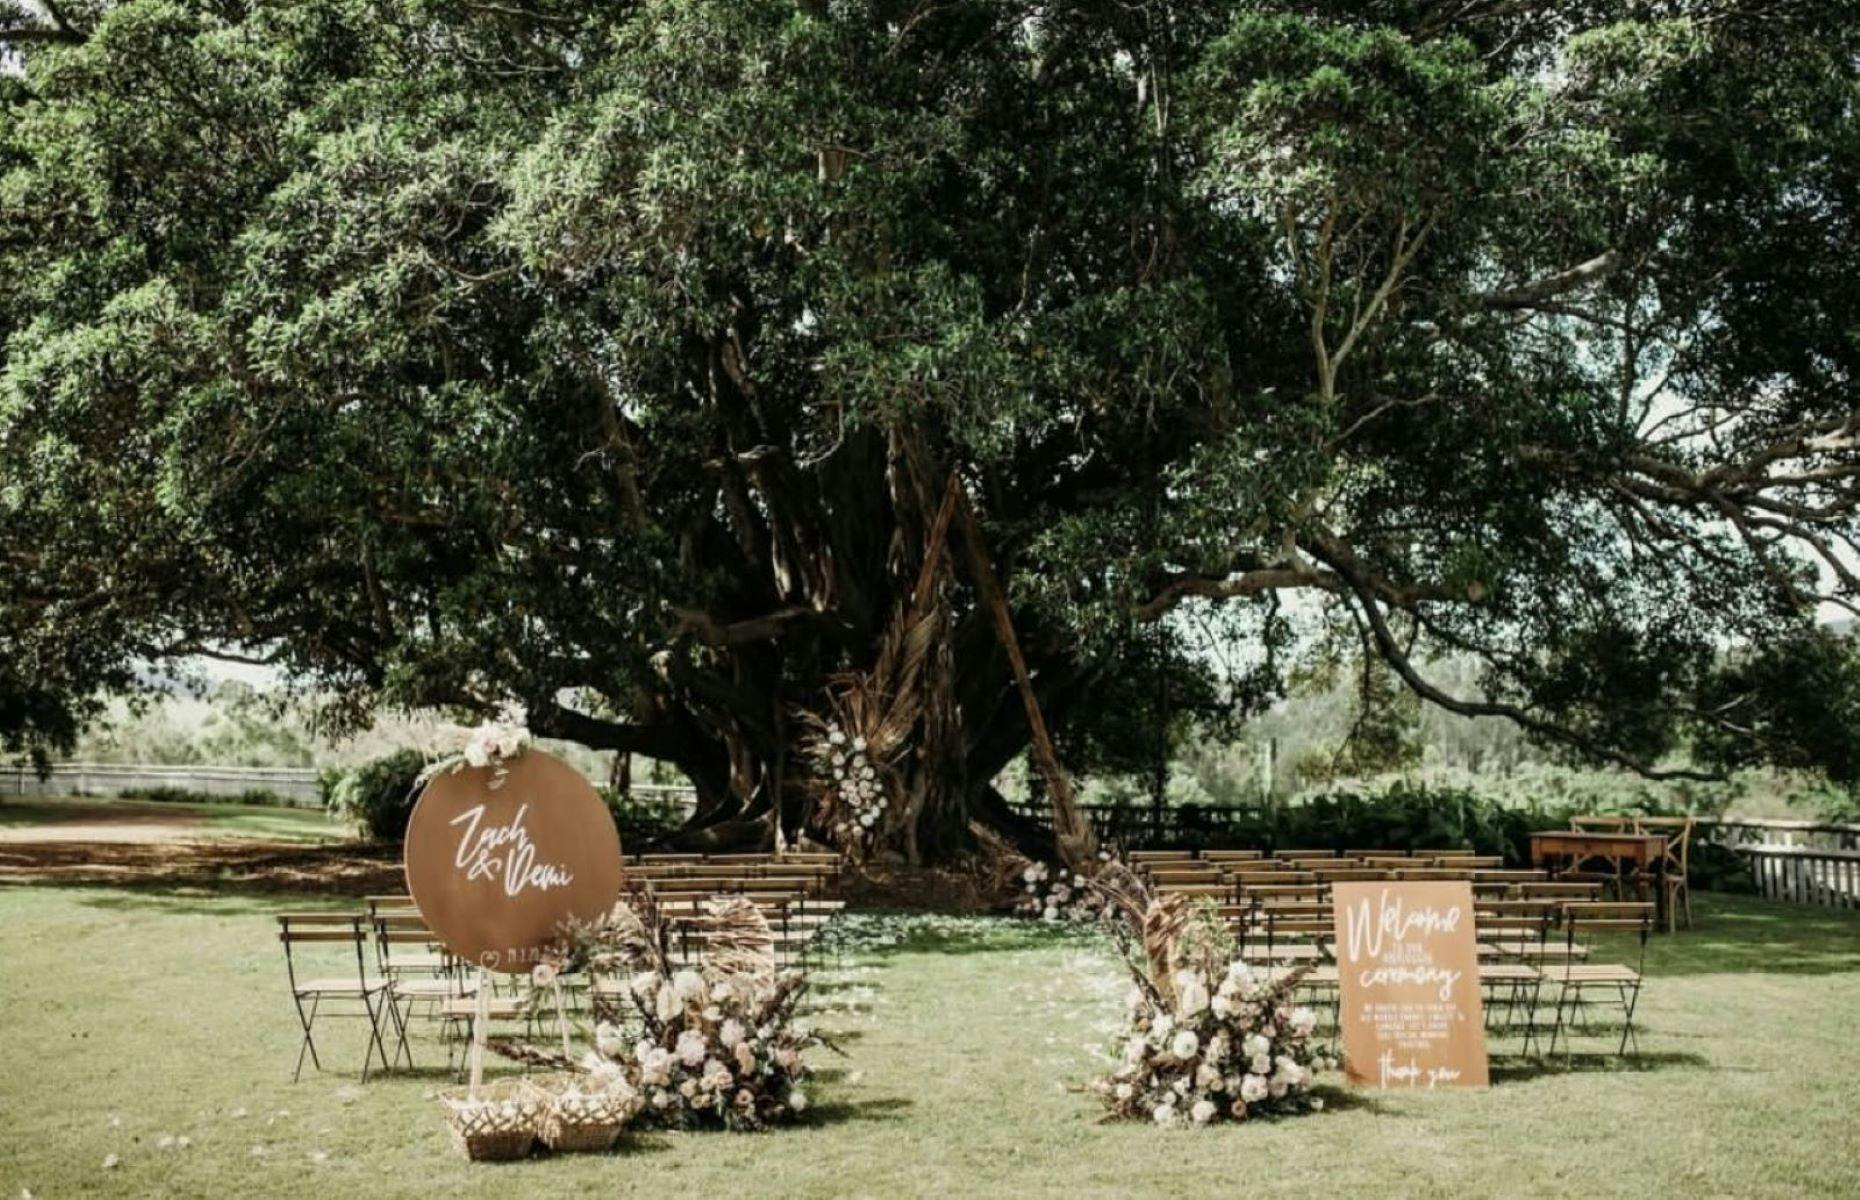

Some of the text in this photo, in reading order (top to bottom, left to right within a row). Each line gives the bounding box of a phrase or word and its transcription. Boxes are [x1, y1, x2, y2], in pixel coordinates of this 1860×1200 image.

[449, 804, 528, 868] Zach
[467, 843, 574, 896] & Demi
[1347, 888, 1461, 962] Welcome
[1360, 966, 1461, 1001] ceremony
[1377, 1047, 1461, 1089] thank you
